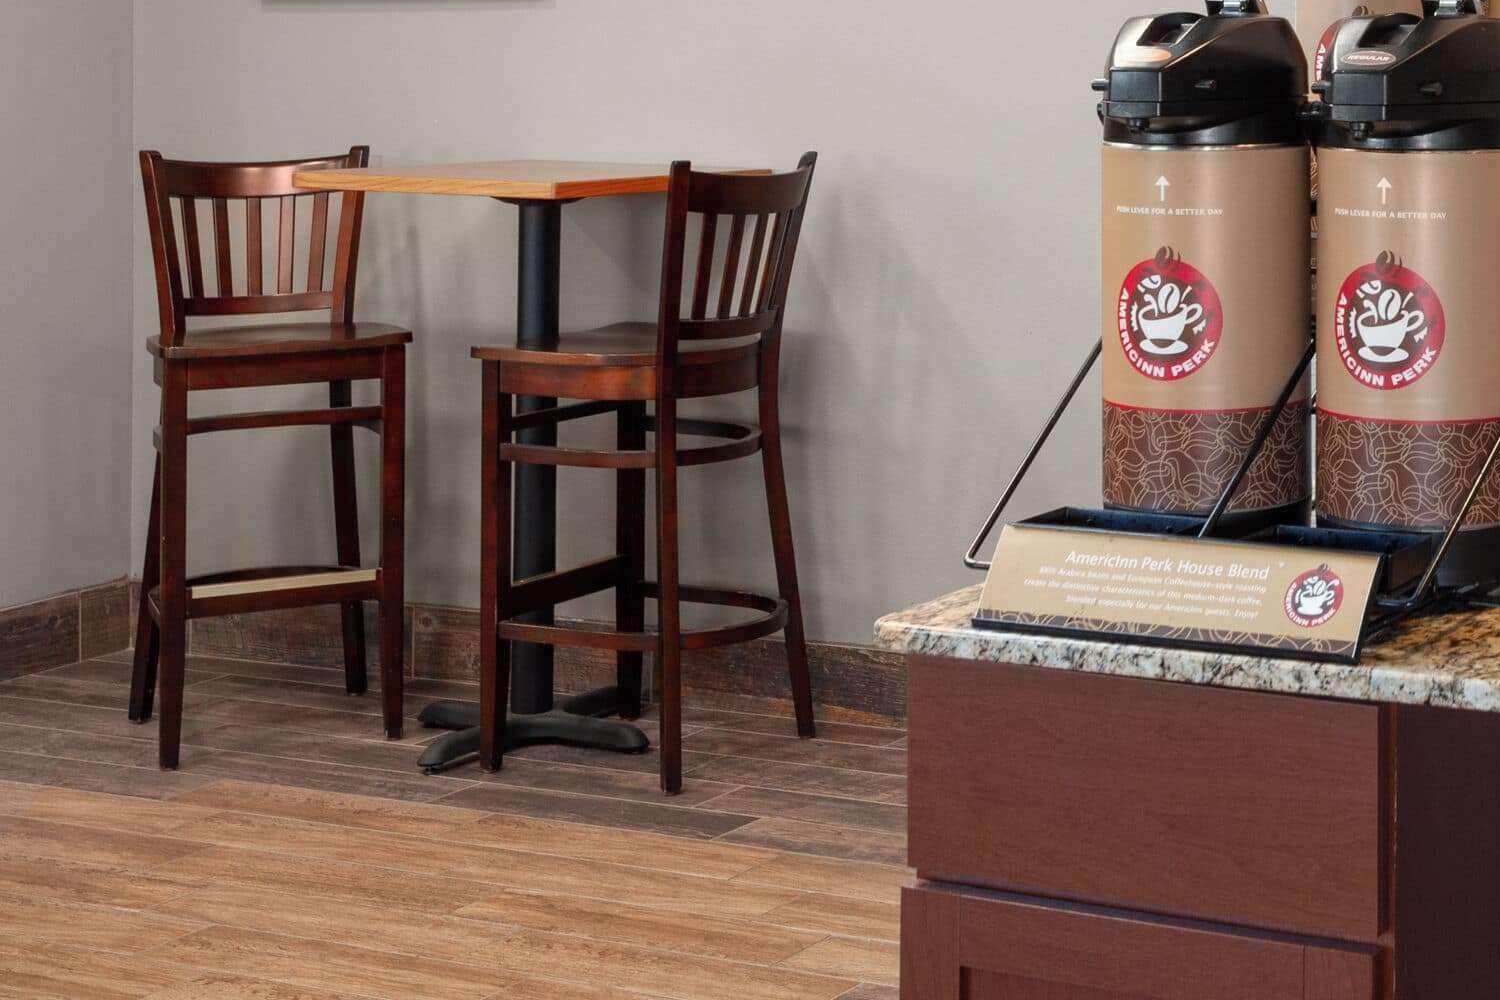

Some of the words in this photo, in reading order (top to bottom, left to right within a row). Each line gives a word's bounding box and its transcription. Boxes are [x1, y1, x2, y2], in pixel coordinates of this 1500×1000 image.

[1118, 286, 1165, 378] AMERICINN
[1170, 338, 1216, 377] PERK
[1336, 292, 1385, 387] AMERICINN
[1391, 346, 1438, 386] PERK
[1141, 556, 1174, 572] Perk
[1177, 560, 1223, 577] House
[1228, 563, 1271, 580] Blend
